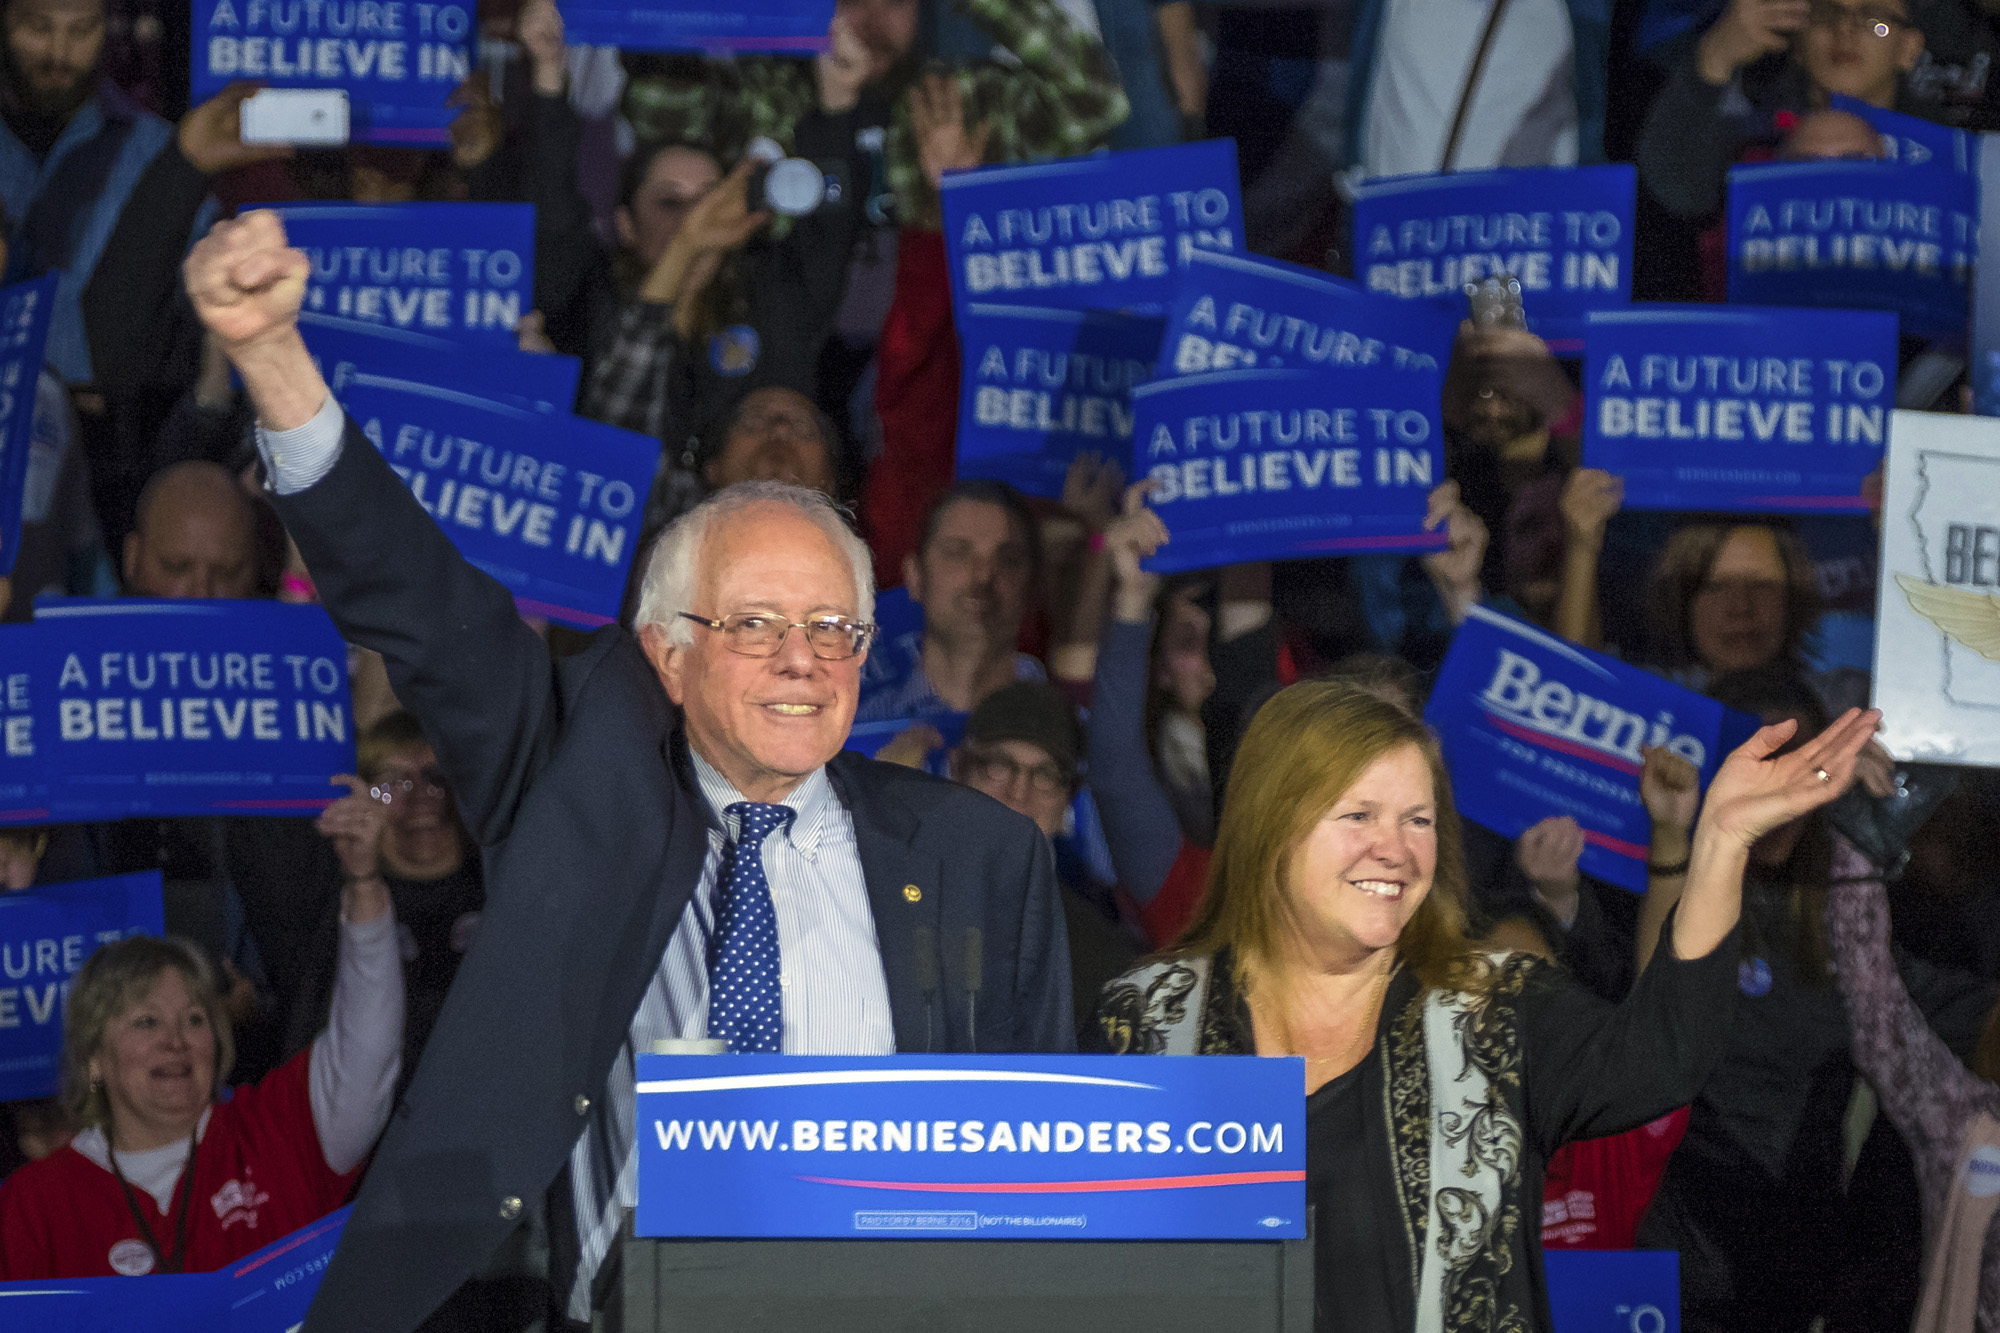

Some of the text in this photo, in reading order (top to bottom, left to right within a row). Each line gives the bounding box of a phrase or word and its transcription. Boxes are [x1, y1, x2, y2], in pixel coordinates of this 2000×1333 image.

[209, 0, 470, 42] A FUTURE TO
[206, 35, 471, 82] BELIEVE IN
[962, 188, 1230, 248] A FUTURE TO
[1368, 210, 1622, 256] A FUTURE TO
[1745, 205, 1773, 233] A
[300, 246, 523, 287] UTURE TO
[964, 234, 1168, 294] BELIEVE
[1561, 252, 1620, 291] IN
[463, 289, 522, 331] IN
[1189, 294, 1216, 330] A
[978, 345, 1008, 378] A
[1602, 354, 1885, 399] A FUTURE TO
[974, 385, 1135, 440] BELIEV
[1149, 408, 1432, 459] A FUTURE TO
[1599, 397, 1886, 446] BELIEVE IN
[394, 423, 568, 503] FUTURE
[575, 469, 637, 520] TO
[1149, 446, 1433, 505] BELIEVE IN
[565, 513, 628, 567] IN
[58, 653, 341, 695] A FUTURE TO
[59, 698, 346, 743] BELIEVE IN
[654, 1119, 1284, 1155] WWW.BERNIESANDERS.COM
